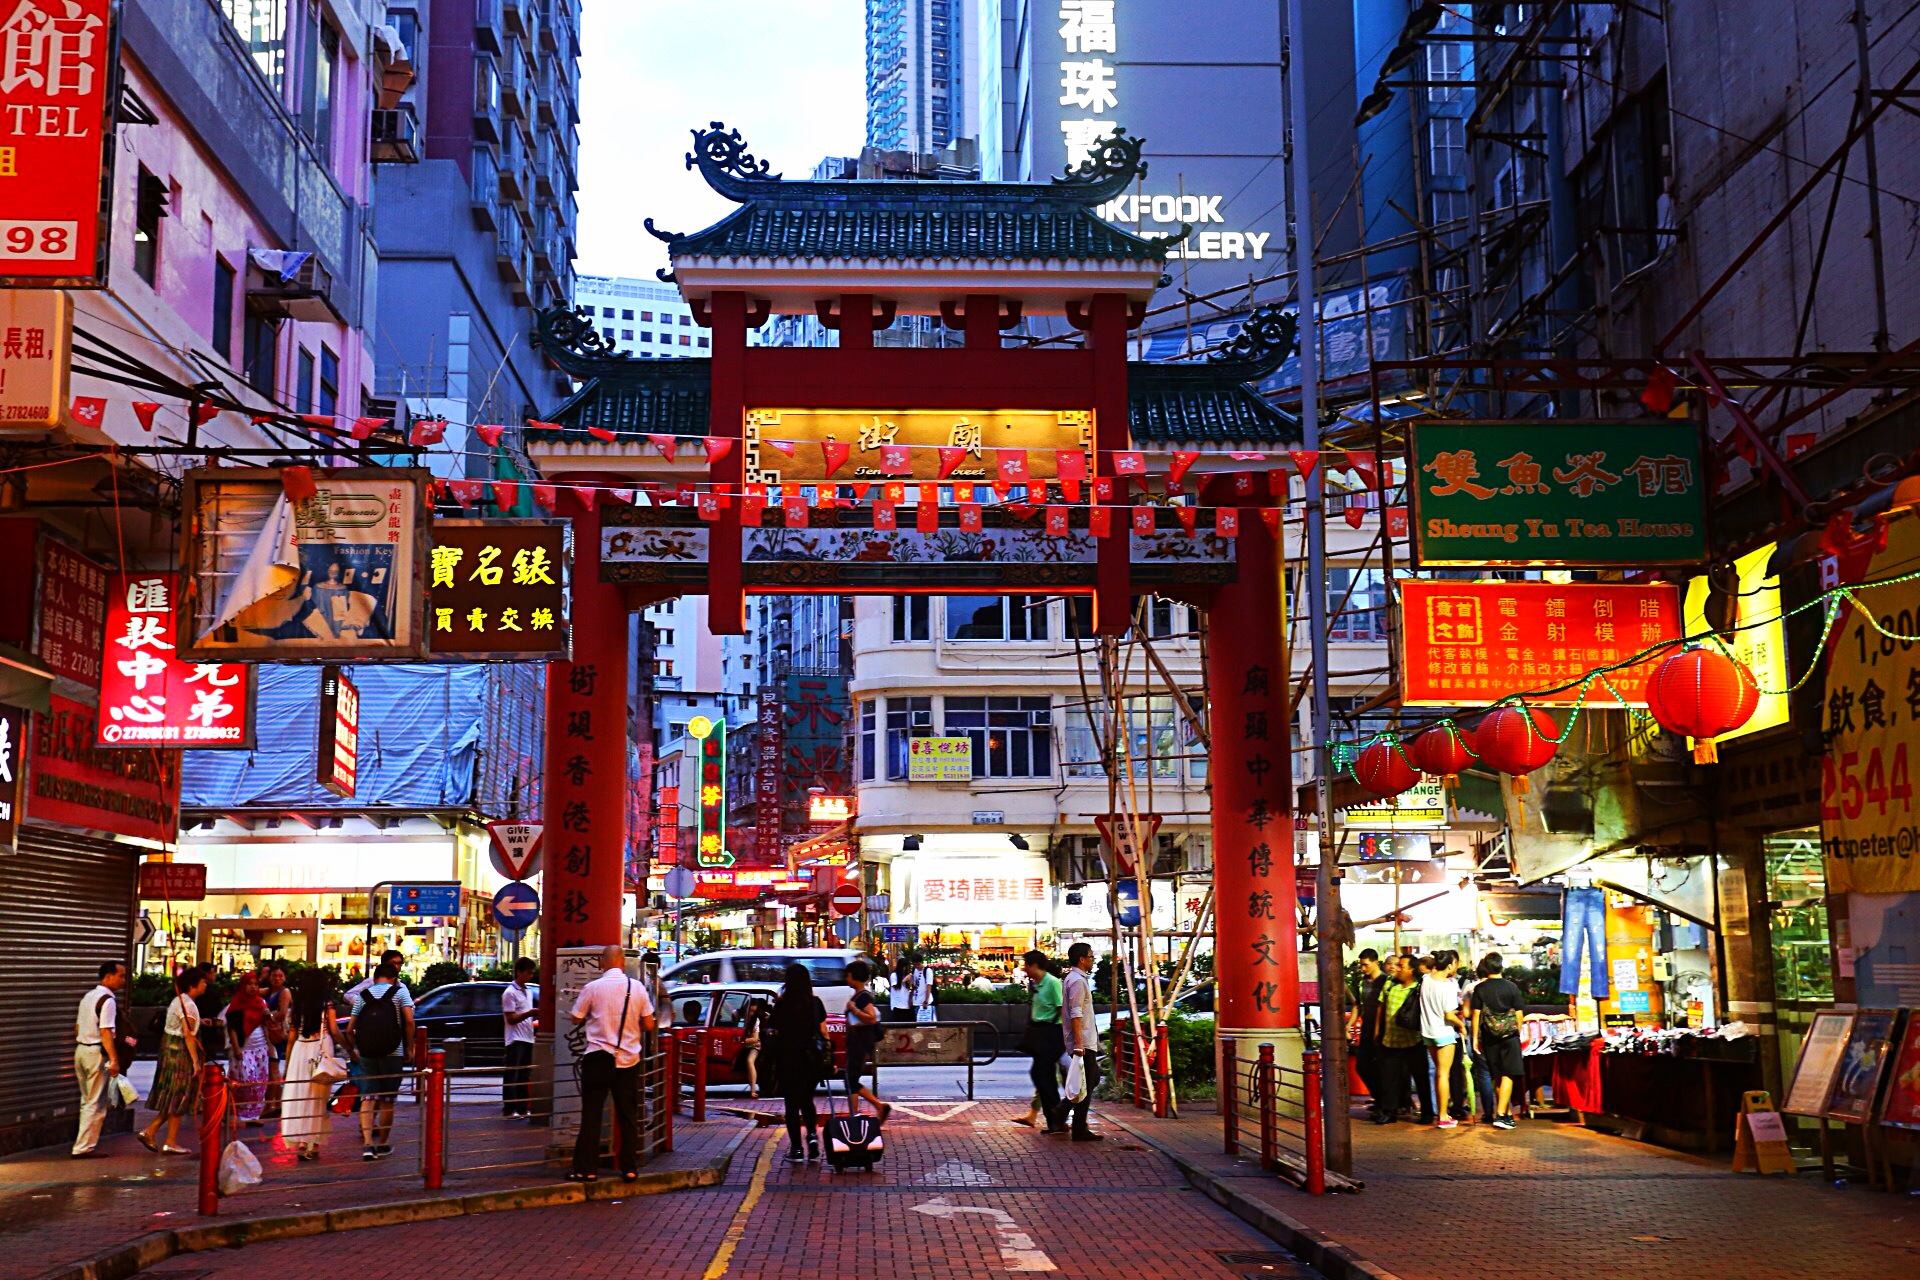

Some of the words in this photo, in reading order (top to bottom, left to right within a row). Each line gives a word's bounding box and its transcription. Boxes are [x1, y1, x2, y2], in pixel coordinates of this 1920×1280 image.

[0, 0, 103, 96] 館
[6, 104, 88, 137] TEL
[6, 227, 68, 254] 98
[1423, 450, 1693, 500] 雙魚茶館
[1427, 518, 1518, 543] Sheung
[1524, 518, 1560, 537] Yu
[1565, 518, 1611, 537] Tea
[1617, 517, 1694, 537] House
[334, 546, 370, 556] Fashion
[375, 546, 393, 557] Key
[430, 545, 556, 589] 寶名錶
[436, 607, 555, 633] 買賣交換
[1854, 606, 1920, 666] 1,80
[1428, 662, 1488, 675] 修改首飾
[1507, 662, 1583, 675] 介指改大細
[508, 836, 529, 844] WAY
